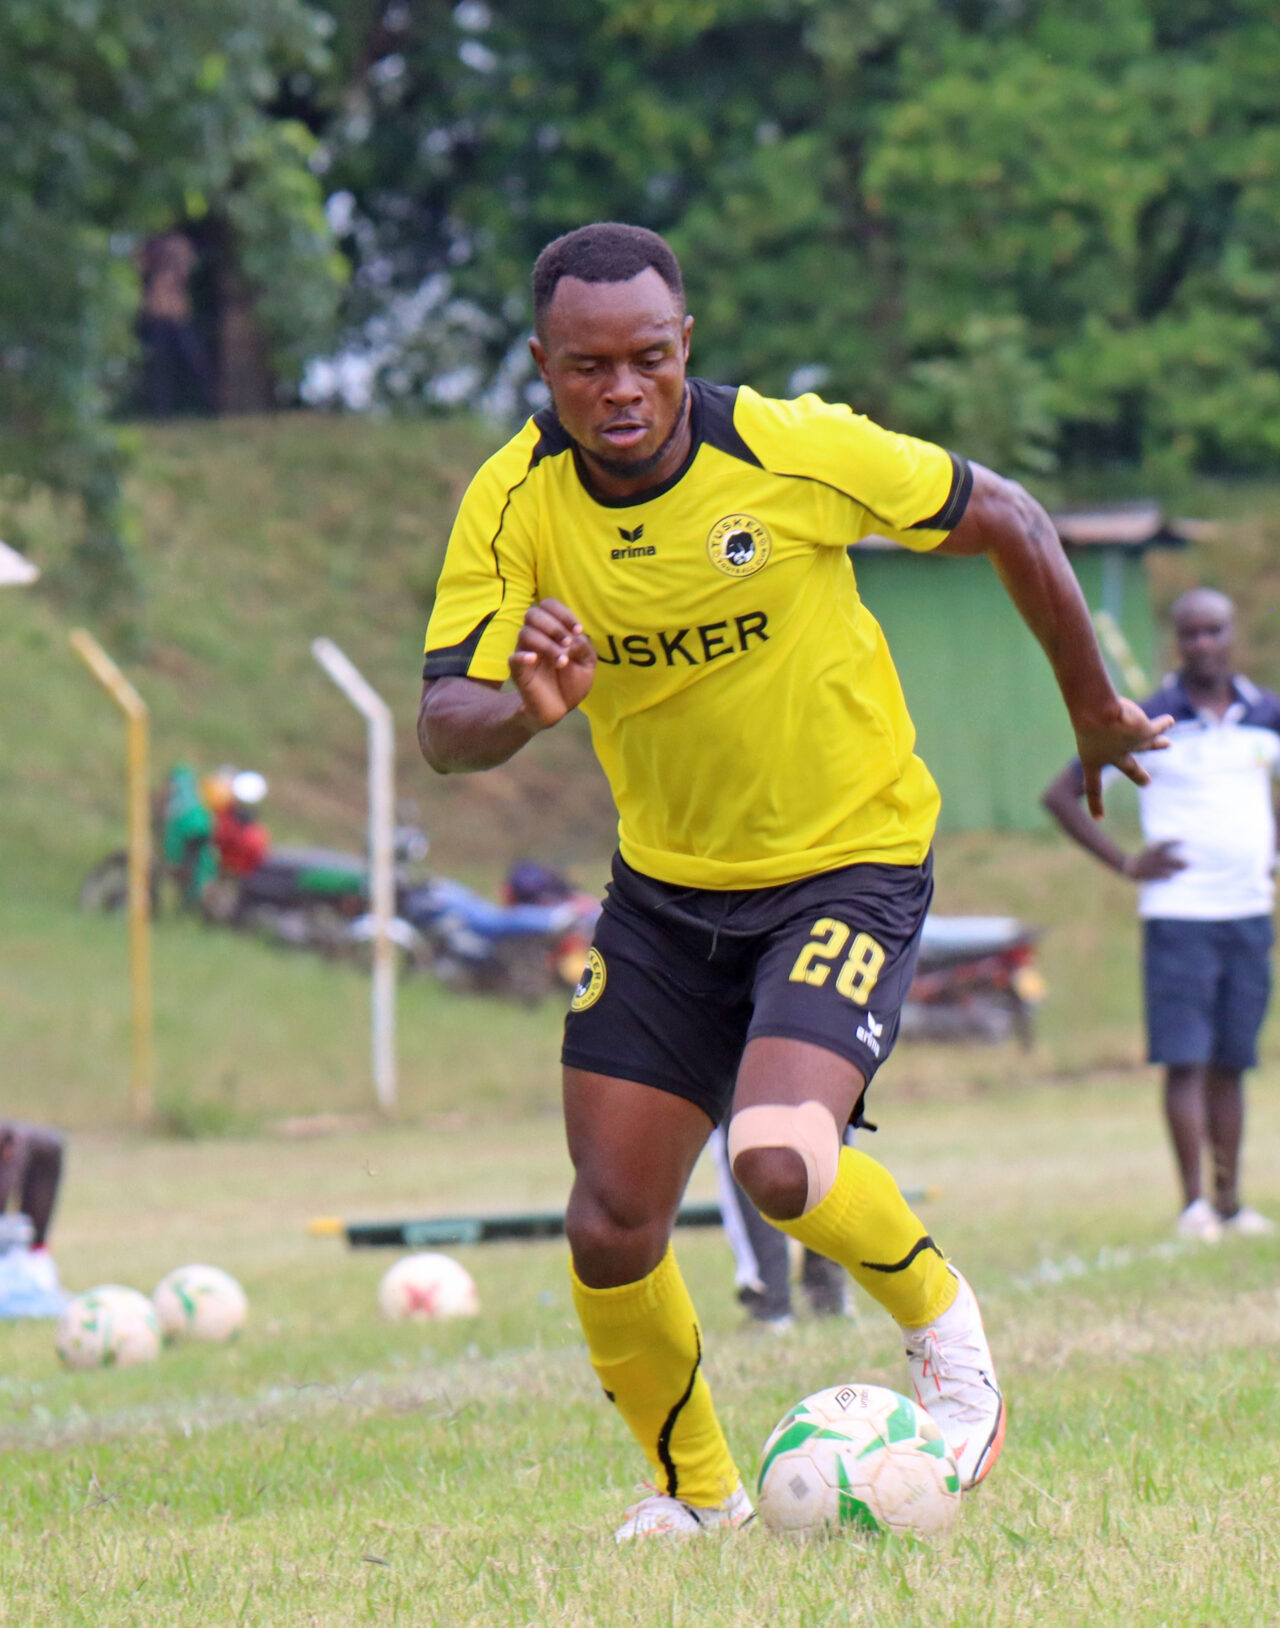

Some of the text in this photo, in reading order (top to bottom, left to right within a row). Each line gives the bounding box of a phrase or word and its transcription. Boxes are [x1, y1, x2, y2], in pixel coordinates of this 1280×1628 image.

[711, 518, 764, 549] TUSKER
[611, 545, 656, 560] erima
[586, 611, 770, 667] USKER
[788, 917, 886, 1007] 28
[855, 1025, 881, 1058] erima
